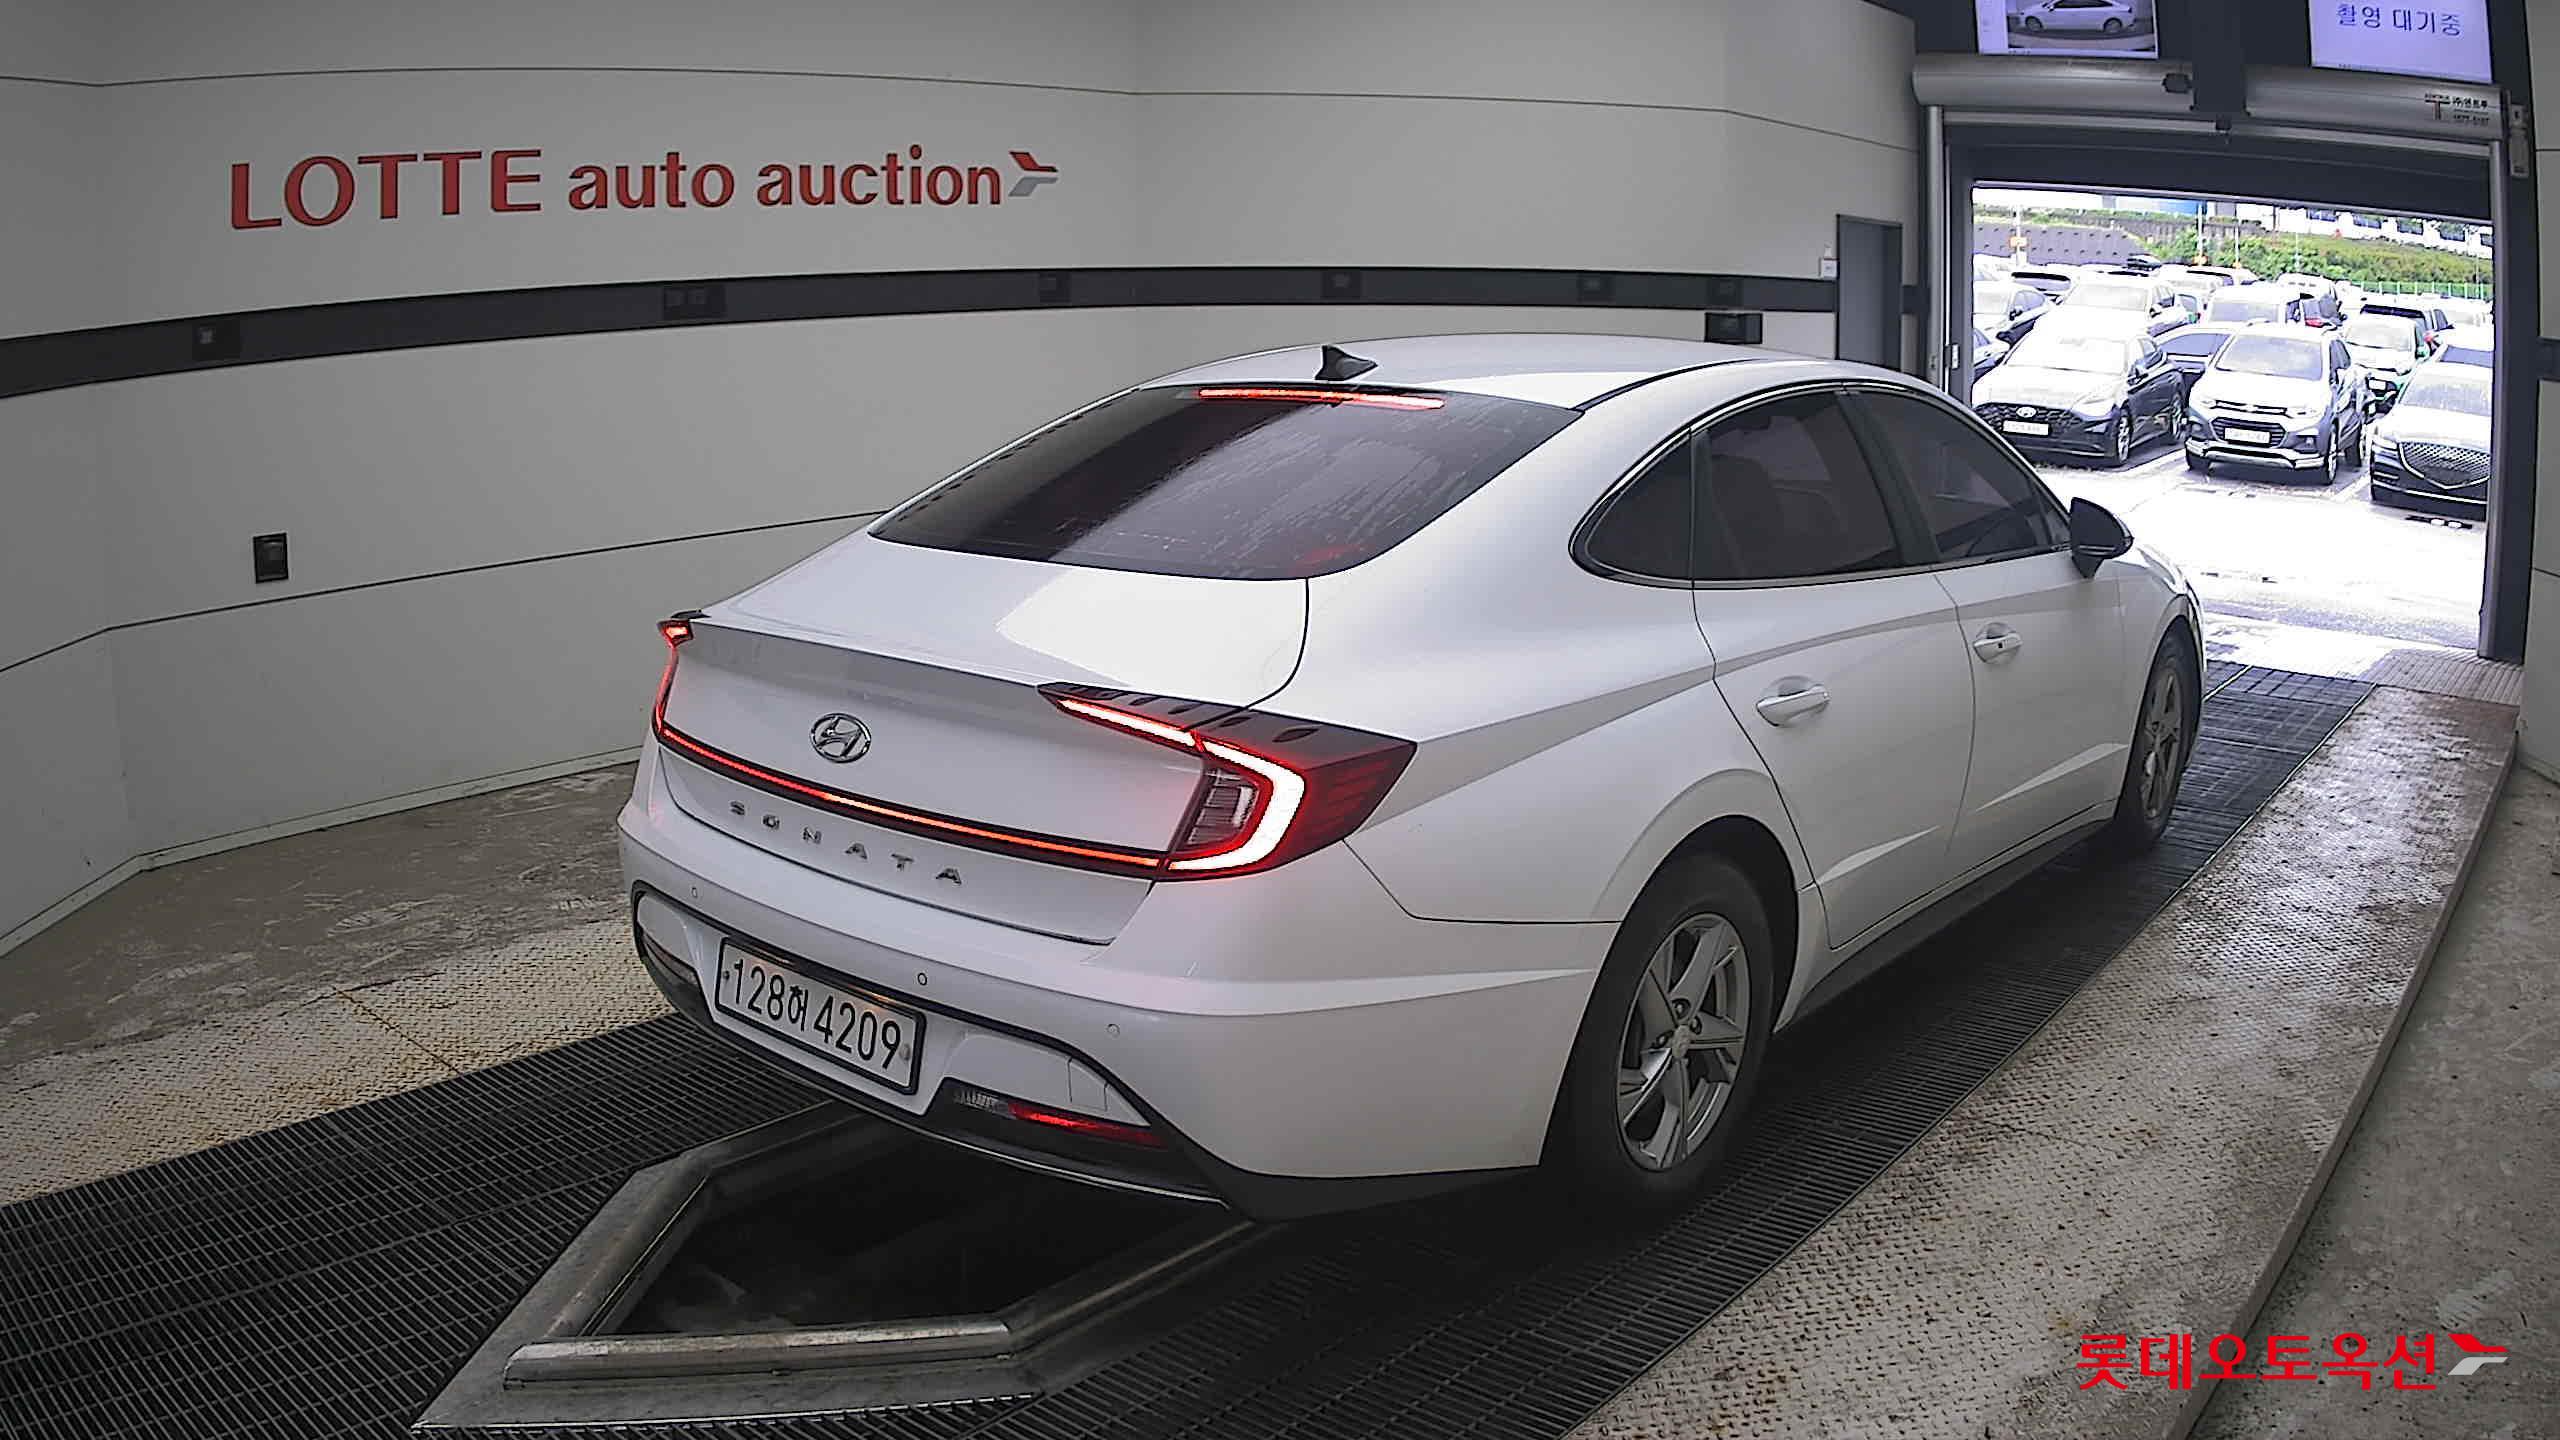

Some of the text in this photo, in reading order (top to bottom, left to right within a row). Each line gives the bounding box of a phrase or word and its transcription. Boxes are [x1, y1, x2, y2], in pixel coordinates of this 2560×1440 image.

[2392, 8, 2461, 37] 대기중
[231, 144, 1001, 230] LOTTE auto auction
[730, 800, 963, 886] SONATA
